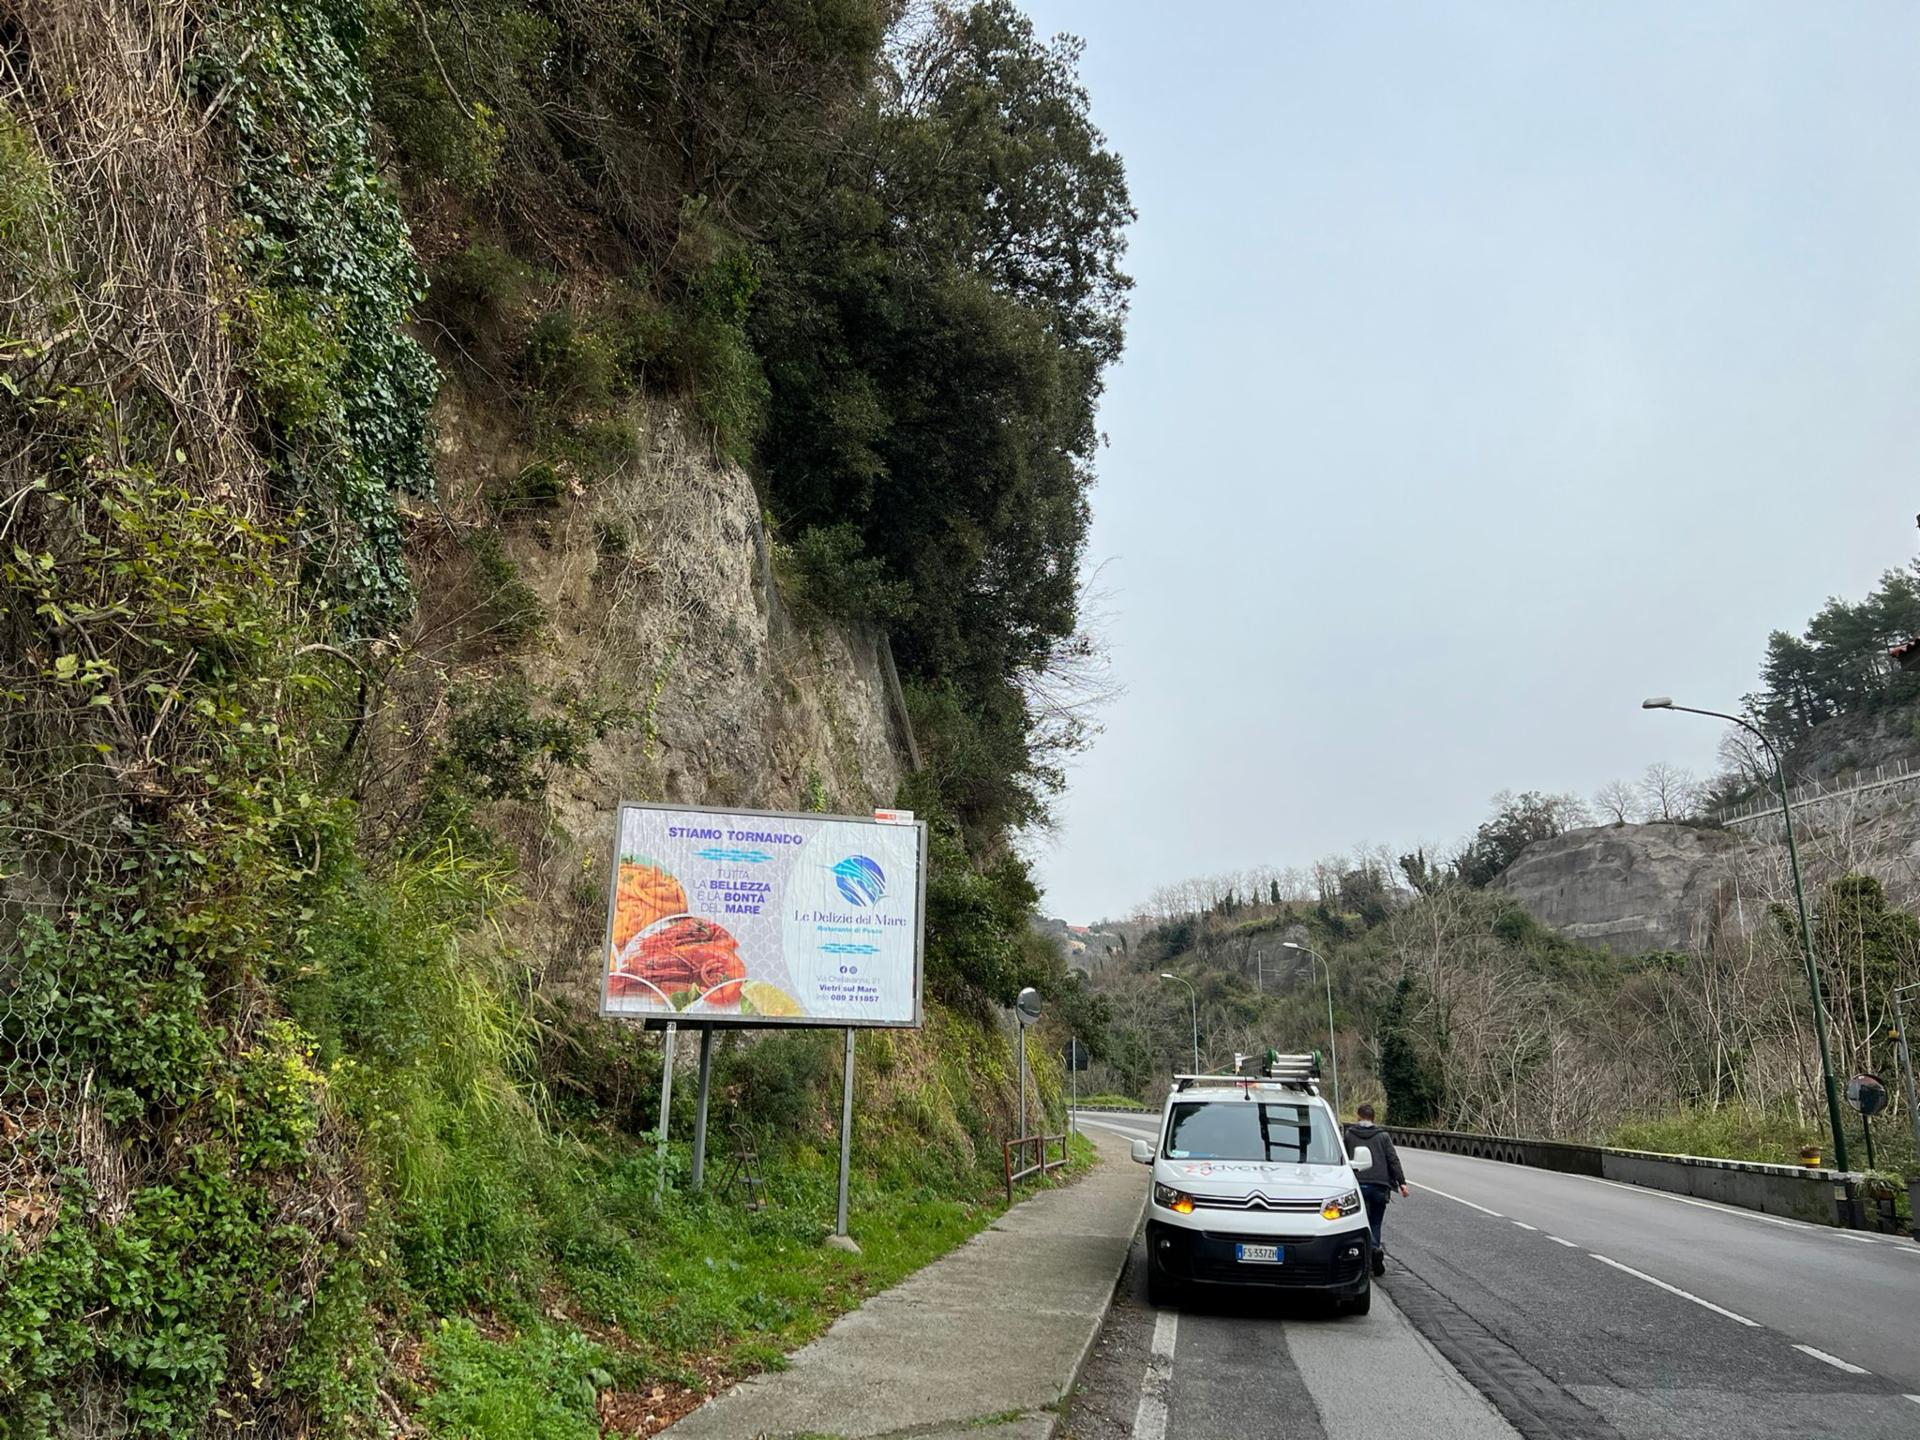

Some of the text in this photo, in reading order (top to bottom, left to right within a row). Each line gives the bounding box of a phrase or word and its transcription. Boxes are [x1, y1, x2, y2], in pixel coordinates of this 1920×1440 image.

[669, 827, 803, 845] STIAMO TORNANDO
[718, 869, 750, 880] TUTTA
[693, 880, 771, 892] LA BELLEZZA
[701, 903, 760, 914] DEL MARE
[875, 914, 907, 926] Mare
